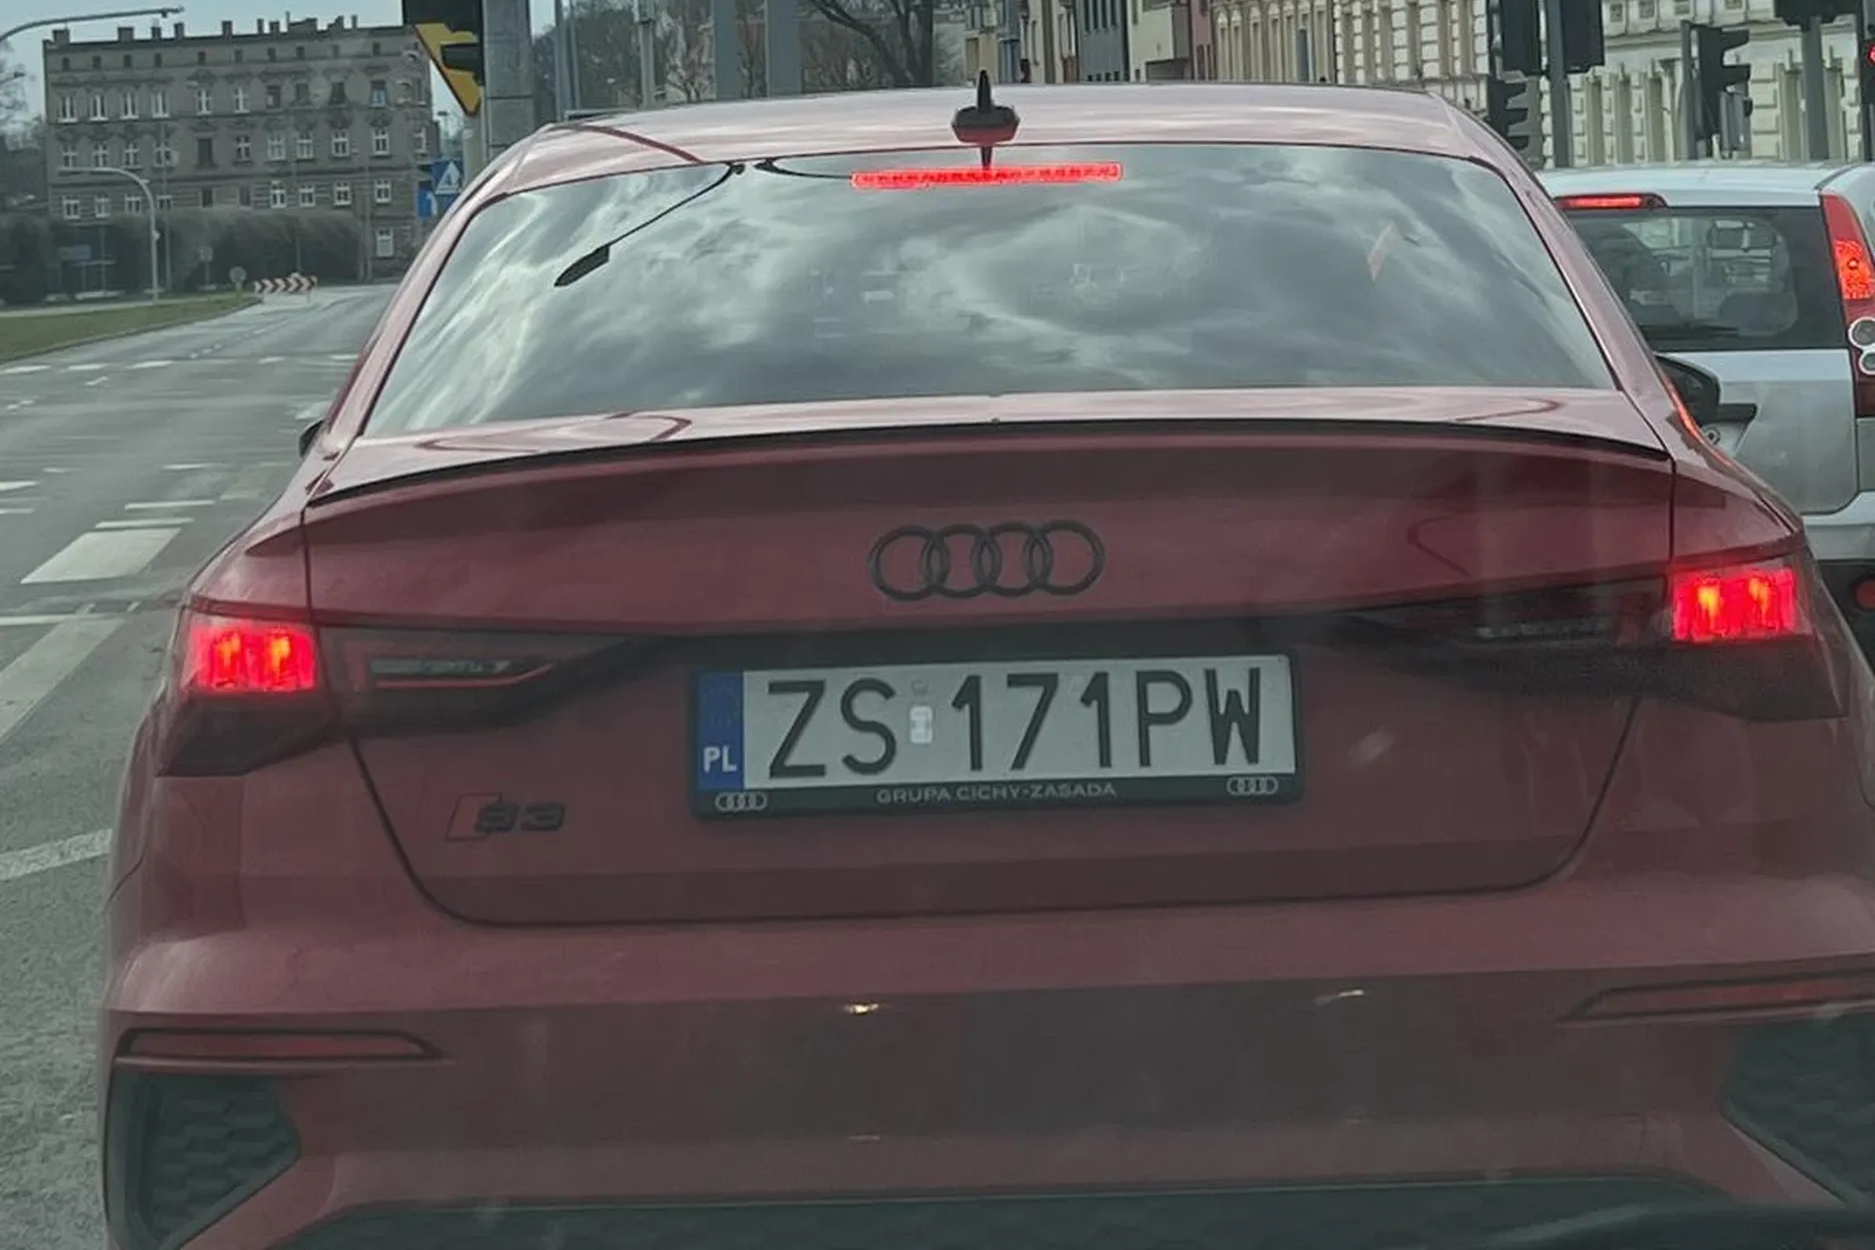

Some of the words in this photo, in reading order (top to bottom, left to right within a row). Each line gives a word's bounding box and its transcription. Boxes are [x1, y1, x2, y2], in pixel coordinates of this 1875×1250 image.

[767, 677, 898, 778] ZS
[951, 667, 1263, 772] 171PW
[703, 745, 737, 773] PL
[876, 787, 951, 804] GRUPA
